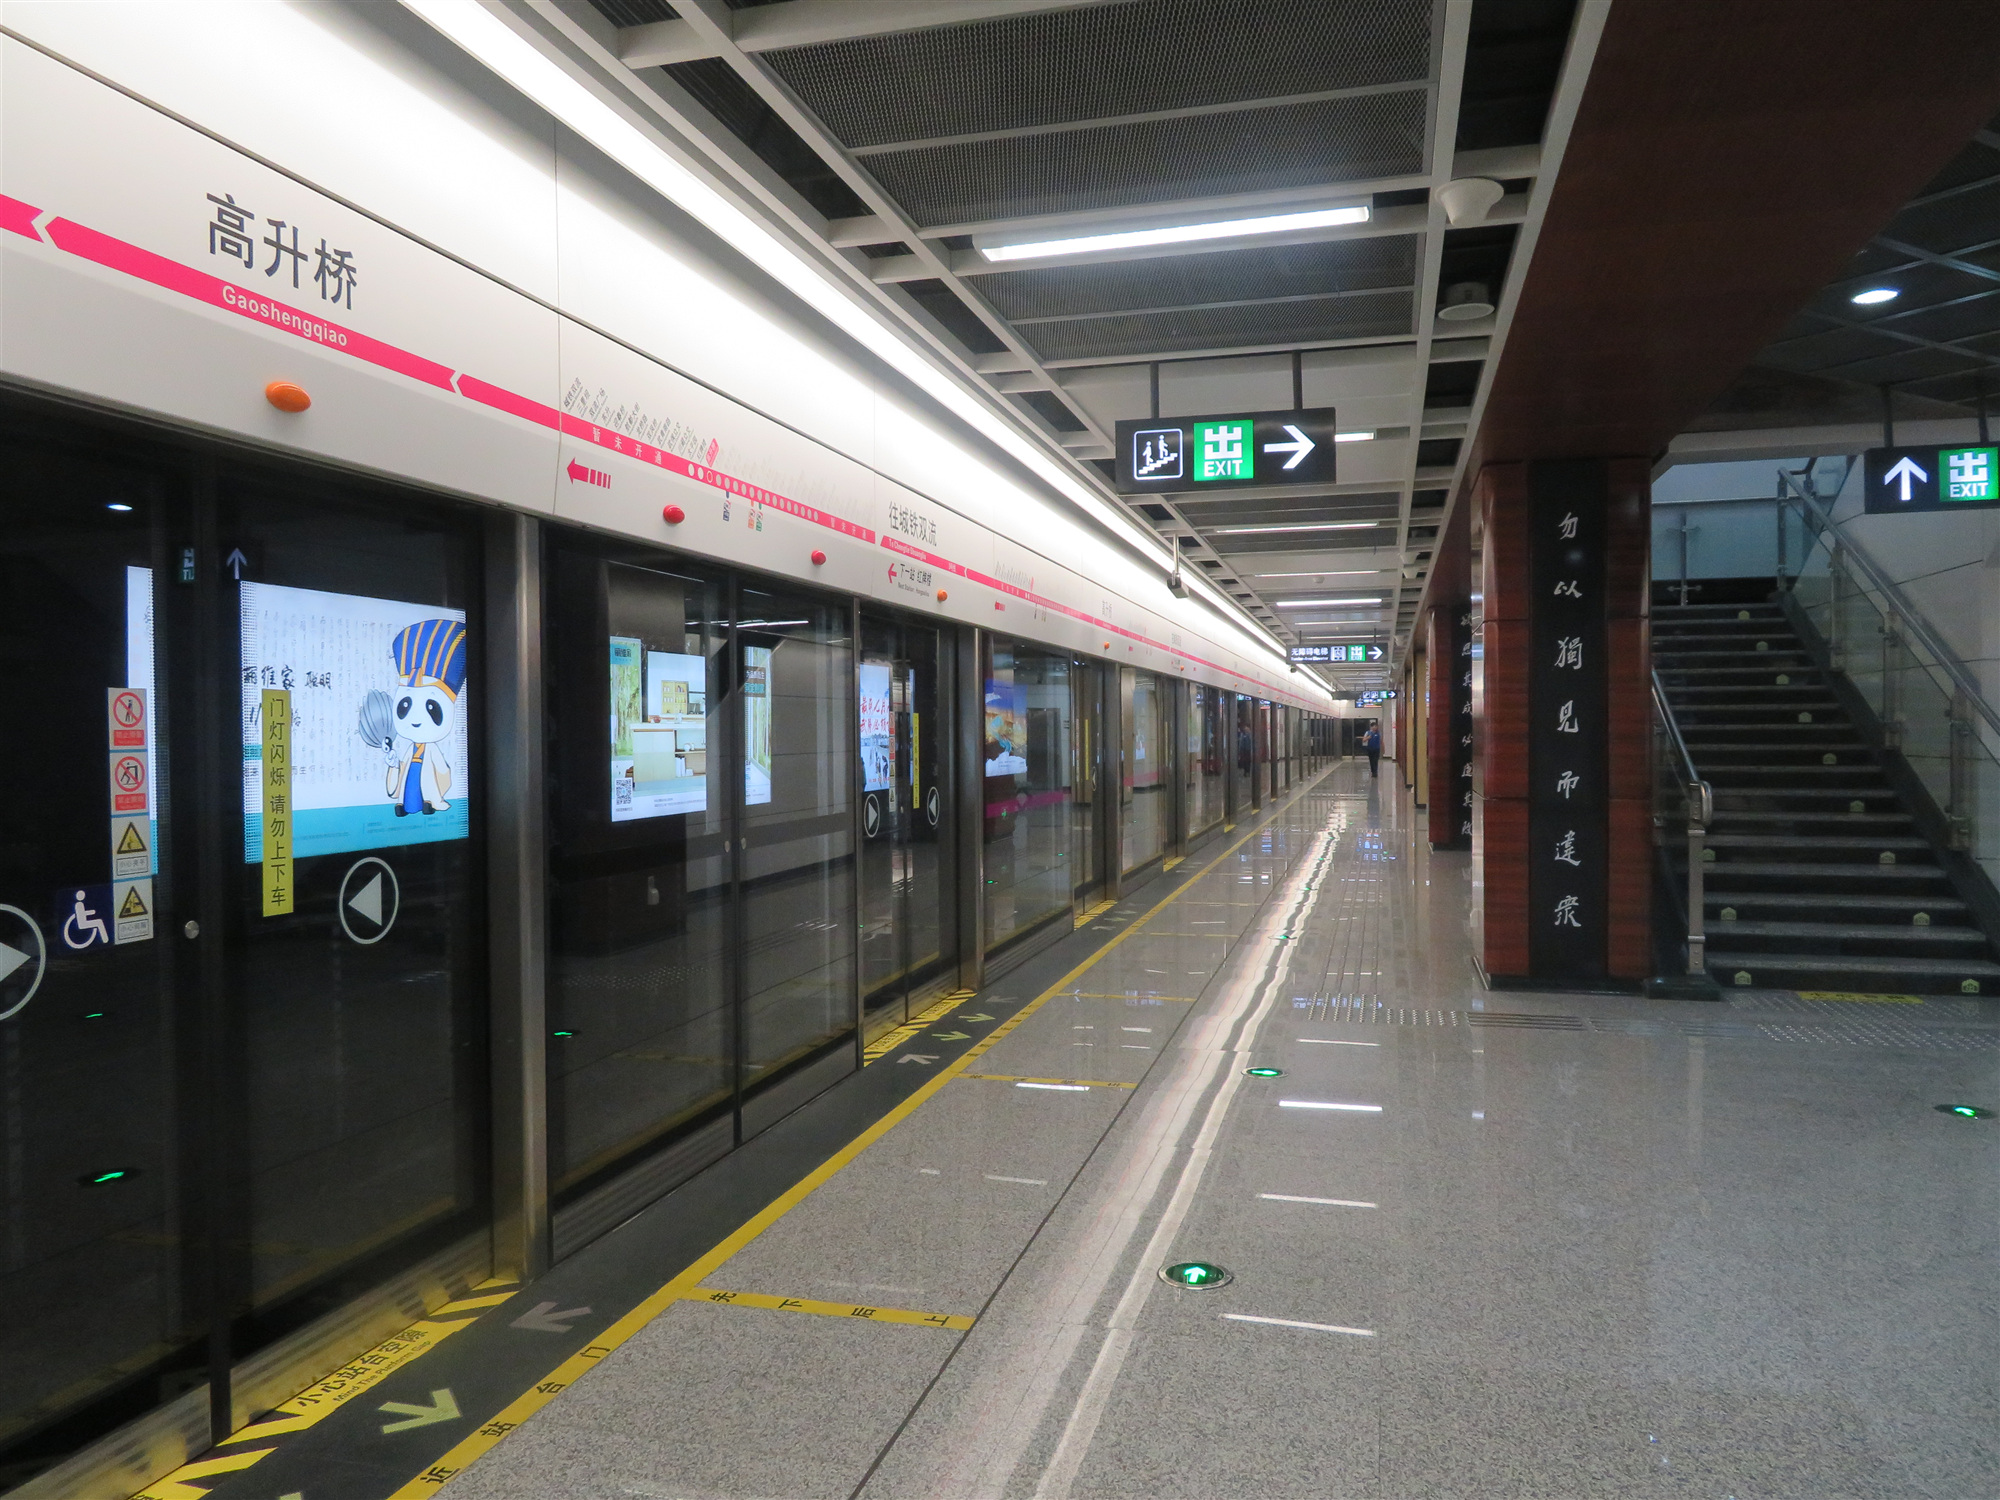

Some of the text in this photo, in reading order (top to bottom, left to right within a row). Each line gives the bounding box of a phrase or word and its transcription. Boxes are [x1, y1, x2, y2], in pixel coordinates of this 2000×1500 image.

[206, 193, 357, 310] 高升桥
[222, 285, 348, 347] Gaoshengqiao
[592, 426, 662, 465] 暂未开通
[1204, 425, 1243, 460] 出
[1204, 460, 1243, 477] EXIT
[1949, 452, 1988, 482] 出
[1949, 482, 1989, 498] EXIT
[888, 500, 937, 547] 往城铁双流
[1291, 647, 1329, 656] 无障碍电梯
[268, 697, 287, 908] 门灯闪烁 请勿上下车
[709, 1291, 950, 1327] 先下后上
[297, 1329, 429, 1407] 小心站台空隙
[333, 1386, 360, 1402] Mind
[358, 1374, 379, 1387] The
[375, 1352, 415, 1375] Platform
